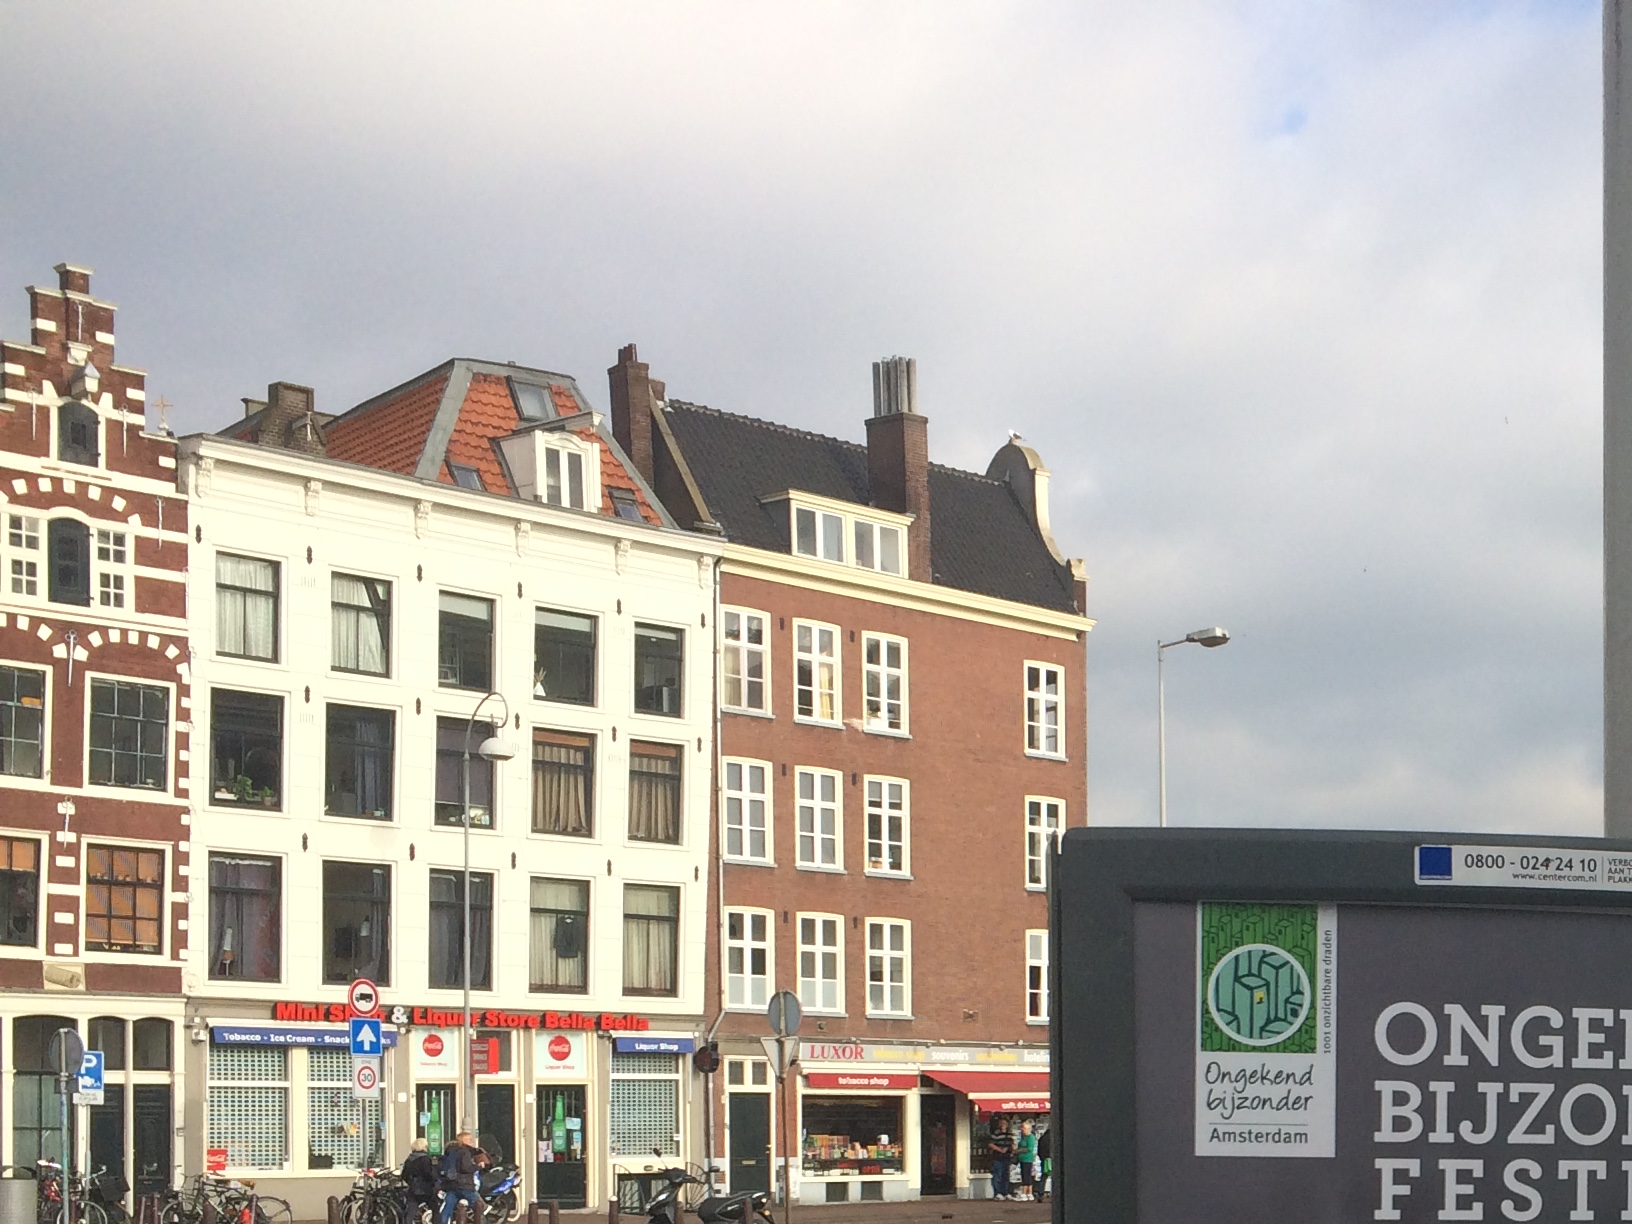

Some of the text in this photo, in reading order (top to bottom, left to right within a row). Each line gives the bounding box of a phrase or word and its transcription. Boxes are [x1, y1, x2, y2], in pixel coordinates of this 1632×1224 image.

[1464, 853, 1505, 869] 0800
[1520, 855, 1550, 871] 024
[1554, 857, 1574, 872] 24
[1579, 858, 1598, 873] 10
[1607, 867, 1626, 876] AAN
[1511, 872, 1598, 883] www.centercom.nl
[1322, 929, 1332, 1055] 1001 onzichtbare draden
[274, 1002, 325, 1022] Mini
[391, 1005, 409, 1024] &
[484, 1010, 540, 1029] Store
[544, 1012, 595, 1030] Bella
[600, 1013, 650, 1032] Bella
[223, 1032, 262, 1041] Tobacco
[269, 1033, 285, 1042] Ice
[286, 1034, 316, 1043] Cream
[324, 1035, 351, 1044] Snack
[635, 1042, 679, 1053] Liquor Shop
[809, 1044, 865, 1060] LUXOR
[931, 1050, 969, 1061] souvenirs
[80, 1055, 97, 1074] P
[361, 1073, 373, 1083] 30
[837, 1076, 890, 1087] tobacco shop
[1204, 1061, 1315, 1095] Ongekend
[1017, 1101, 1040, 1110] drinks
[1206, 1088, 1314, 1120] bijzonder
[1208, 1127, 1309, 1144] Amsterdam
